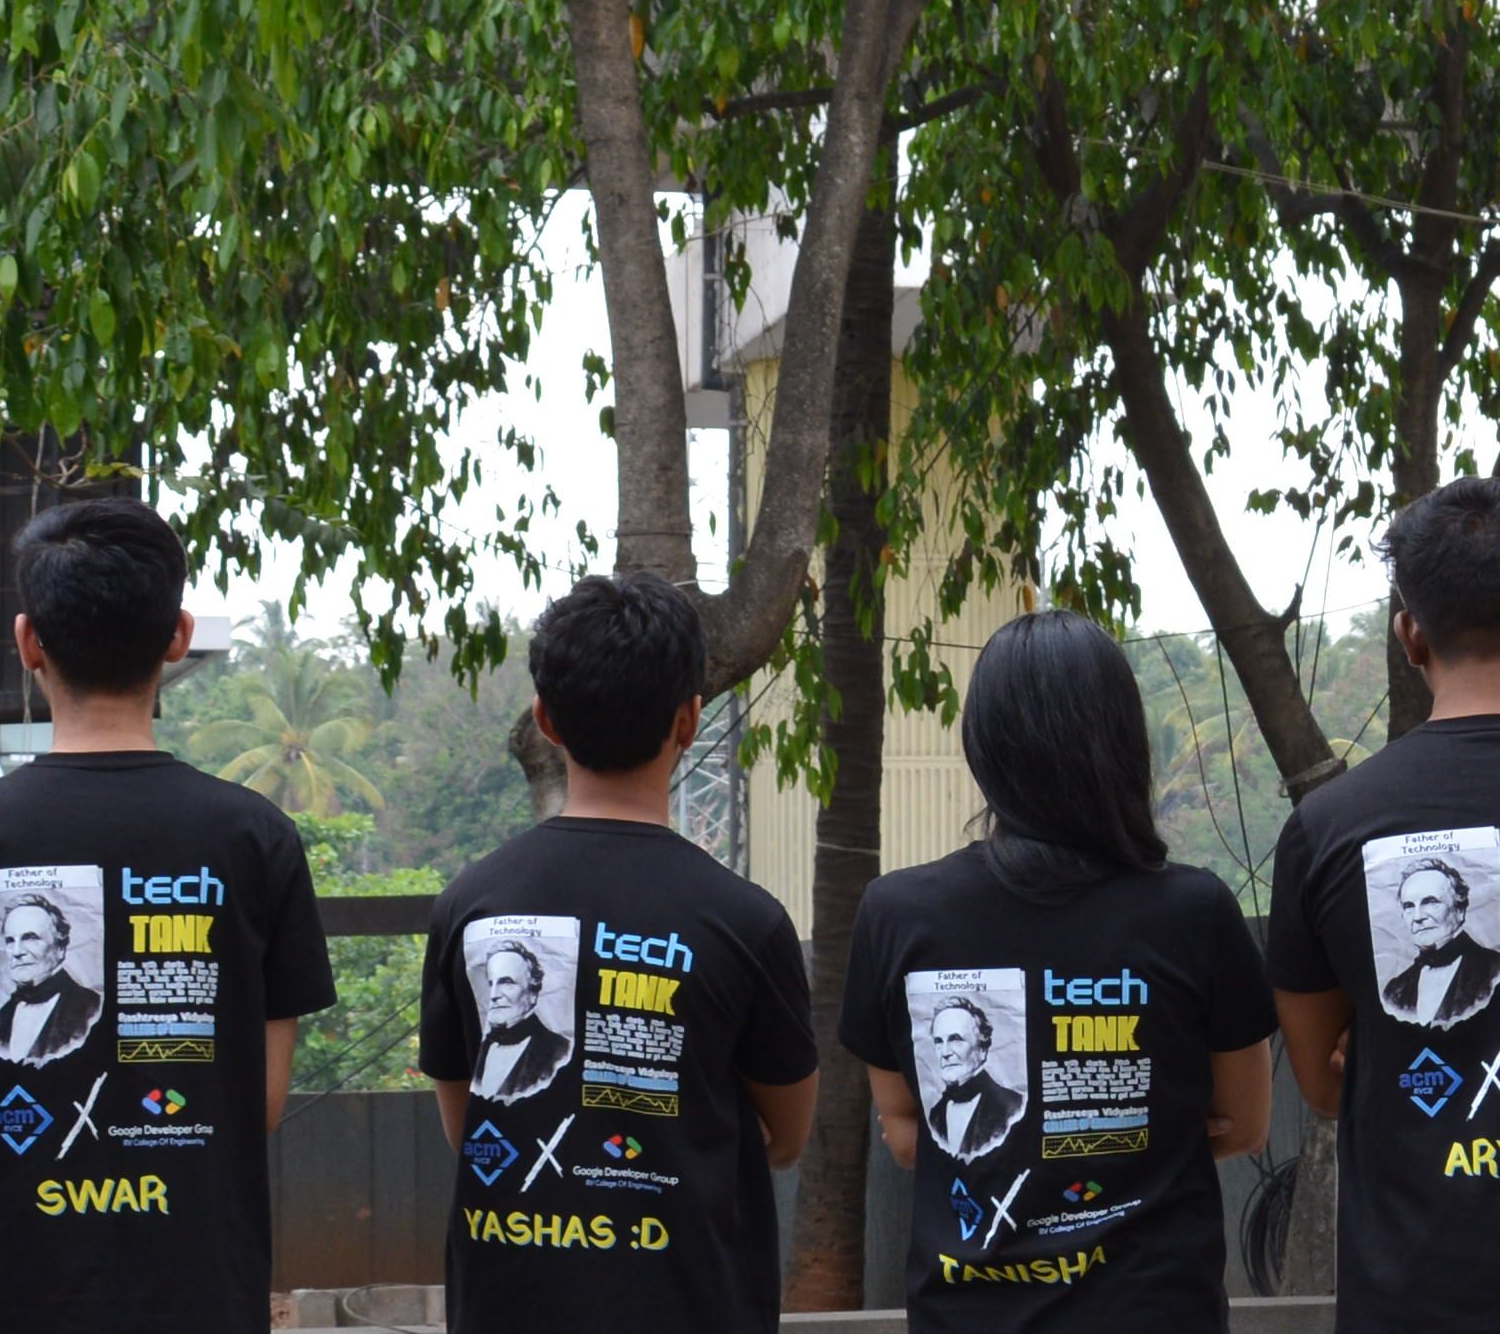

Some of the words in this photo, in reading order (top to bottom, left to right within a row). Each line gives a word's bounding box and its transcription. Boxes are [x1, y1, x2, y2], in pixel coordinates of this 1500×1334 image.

[1405, 834, 1440, 844] Father
[1443, 831, 1453, 840] of
[1402, 843, 1460, 854] Technology
[7, 869, 44, 877] Father
[46, 868, 57, 876] of
[4, 879, 63, 888] Technology
[122, 867, 224, 906] tech
[493, 918, 522, 926] Father
[527, 917, 537, 925] of
[129, 915, 214, 954] TANK
[489, 928, 542, 937] Technology
[594, 922, 693, 973] tech
[938, 971, 967, 980] Father
[972, 970, 982, 979] of
[598, 969, 680, 1016] TANK
[934, 982, 987, 992] Technology
[1044, 968, 1148, 1006] tech
[1052, 1015, 1140, 1052] TANK
[1399, 1070, 1444, 1087] acm
[108, 1125, 142, 1137] Google
[143, 1124, 193, 1136] Developer
[572, 1166, 604, 1178] Google
[604, 1167, 649, 1180] Developer
[650, 1171, 679, 1186] Group
[35, 1174, 169, 1215] SWAR
[1027, 1214, 1060, 1228] Google
[1060, 1208, 1108, 1223] Developer
[464, 1207, 617, 1250] YASHAS
[631, 1217, 669, 1250] :D
[938, 1245, 1106, 1284] TANISHA
